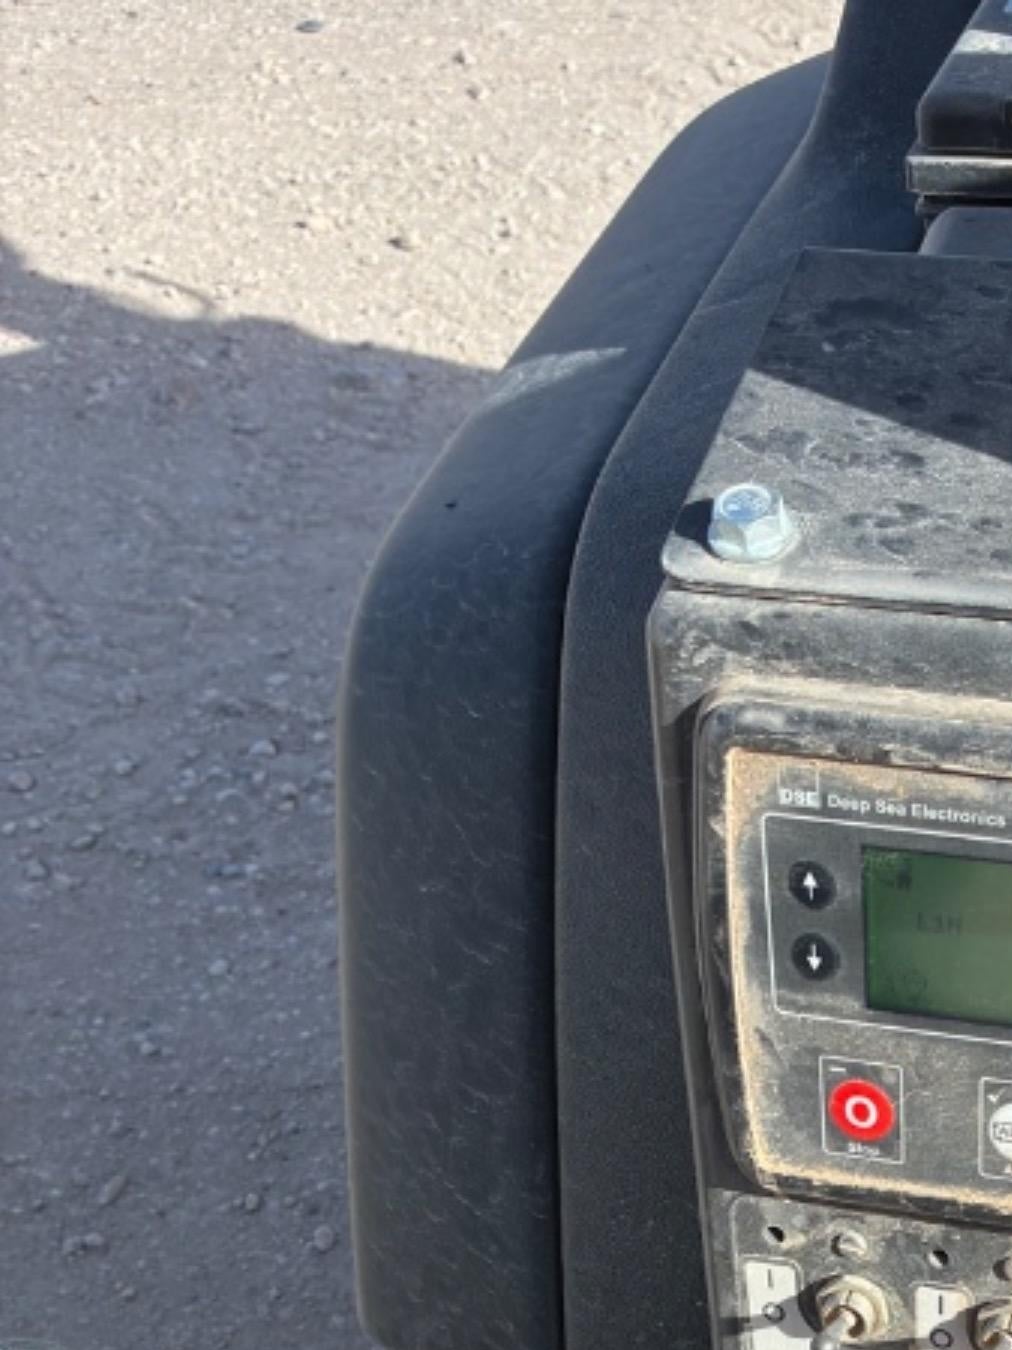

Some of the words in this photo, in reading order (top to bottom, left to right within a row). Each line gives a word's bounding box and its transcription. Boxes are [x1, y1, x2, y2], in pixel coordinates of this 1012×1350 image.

[778, 788, 821, 809] DSE
[827, 794, 871, 816] Deep
[875, 799, 906, 817] Sea
[911, 803, 1007, 828] Electronics
